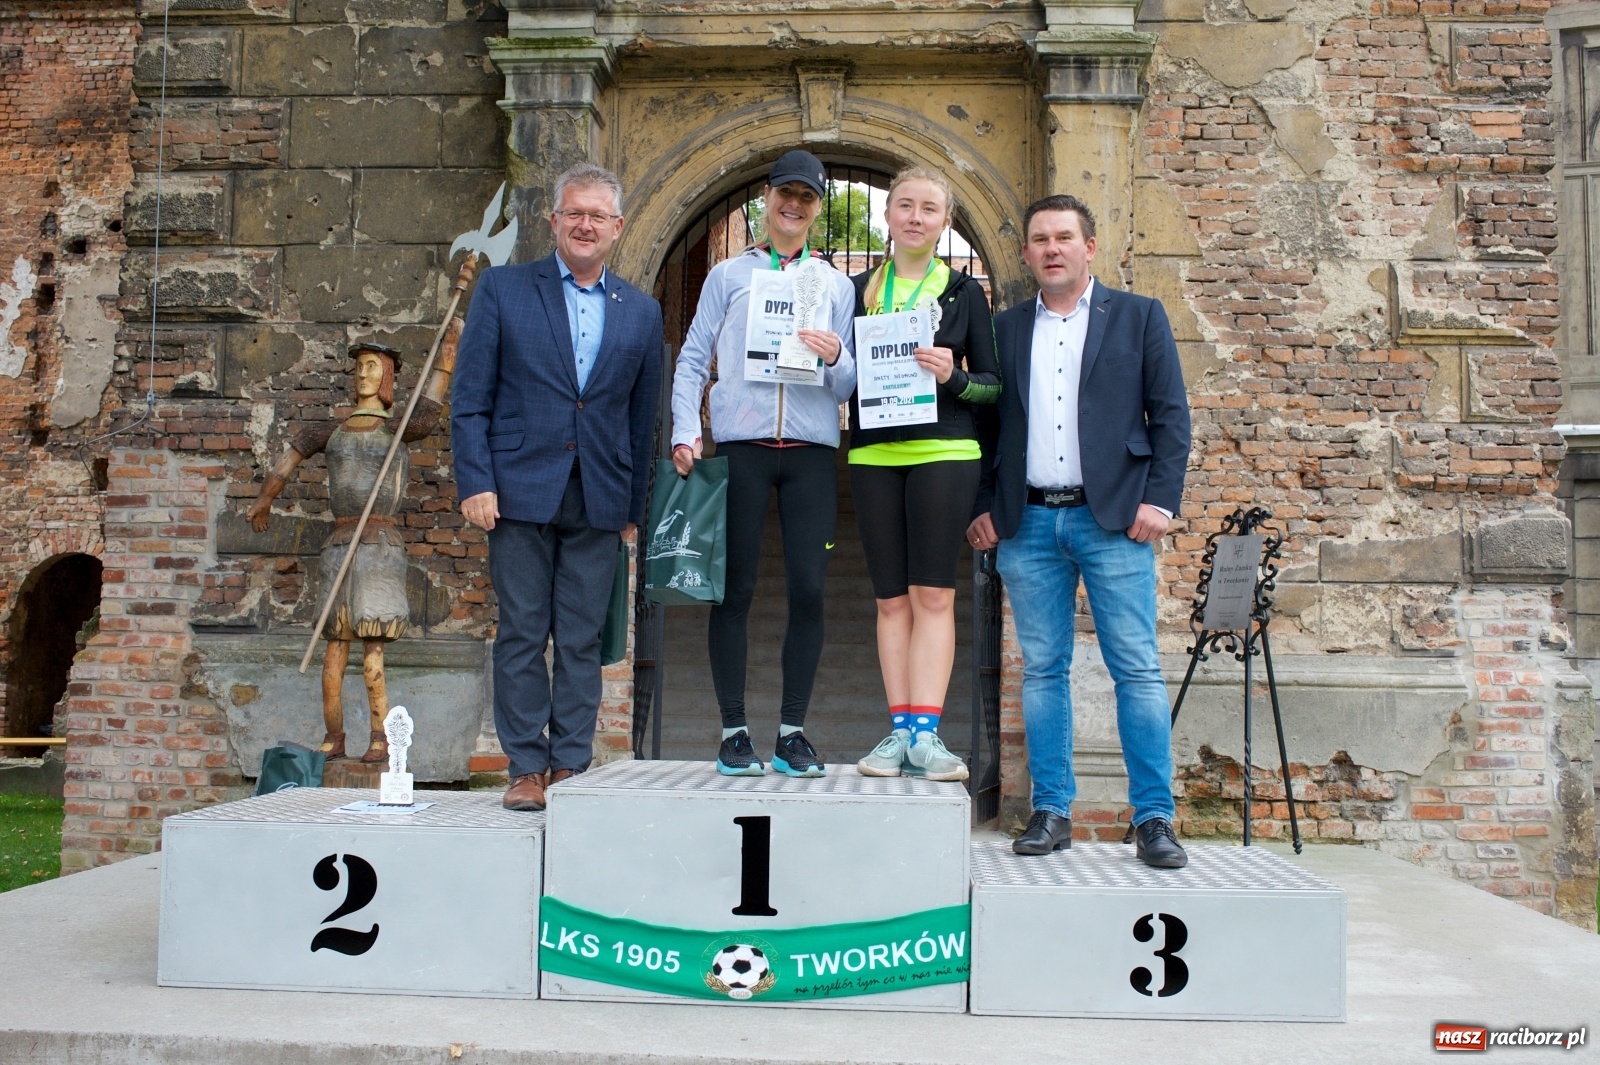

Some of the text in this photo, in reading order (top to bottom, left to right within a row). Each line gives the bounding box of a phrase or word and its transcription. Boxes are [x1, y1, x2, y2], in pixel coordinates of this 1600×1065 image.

[765, 300, 795, 316] DYPL
[871, 341, 919, 360] DYPLOM
[880, 395, 915, 406] 19.09.2021
[732, 816, 778, 916] 1
[311, 853, 379, 956] 2
[540, 921, 680, 974] LKS 1905
[790, 931, 966, 978] TWORKÓW
[1130, 913, 1189, 997] 3
[794, 986, 810, 994] na
[813, 978, 854, 996] przekór
[883, 976, 896, 985] co
[911, 971, 931, 981] nas
[934, 966, 952, 977] nie
